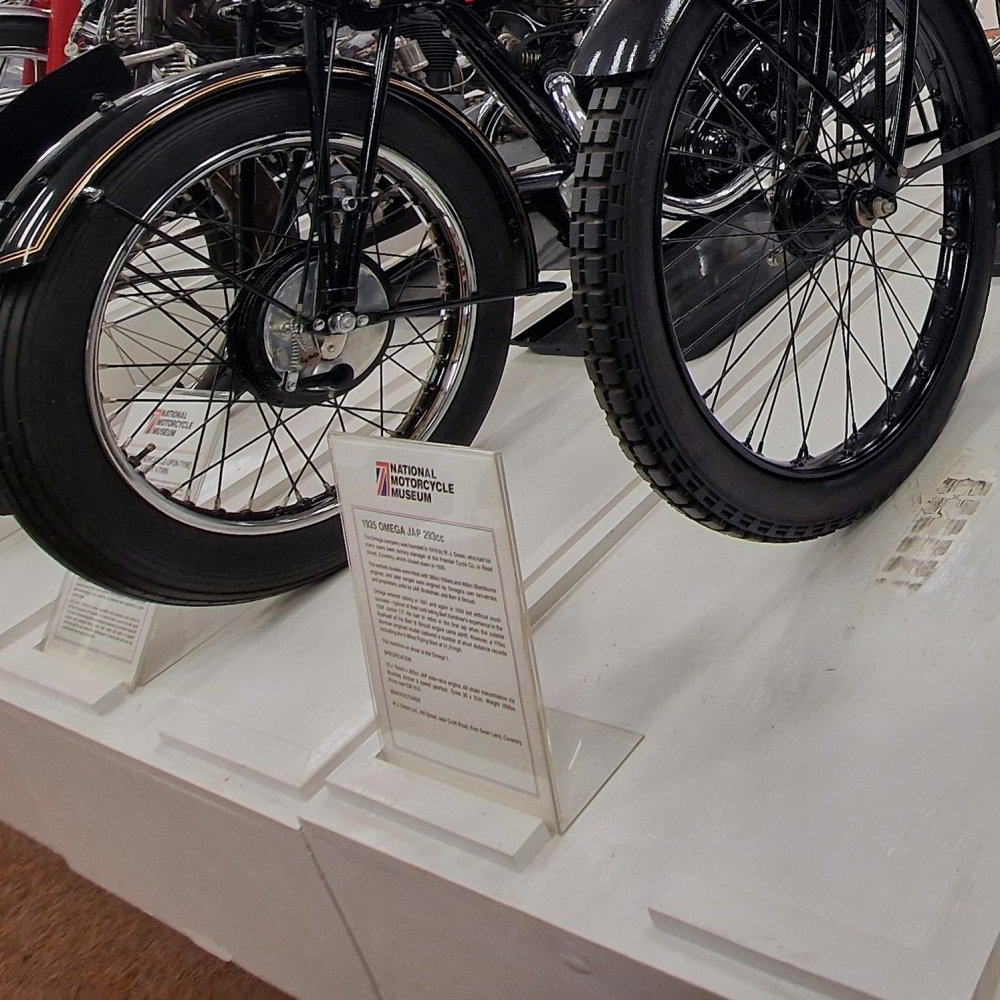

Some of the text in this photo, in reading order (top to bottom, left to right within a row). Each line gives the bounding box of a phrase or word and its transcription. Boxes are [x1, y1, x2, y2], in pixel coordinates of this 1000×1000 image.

[390, 463, 437, 479] NATIONAL
[390, 475, 455, 494] MOTORCYCLE
[391, 487, 432, 503] MUSEUM
[362, 519, 445, 543] 1925 OMEGA JAP 293cc
